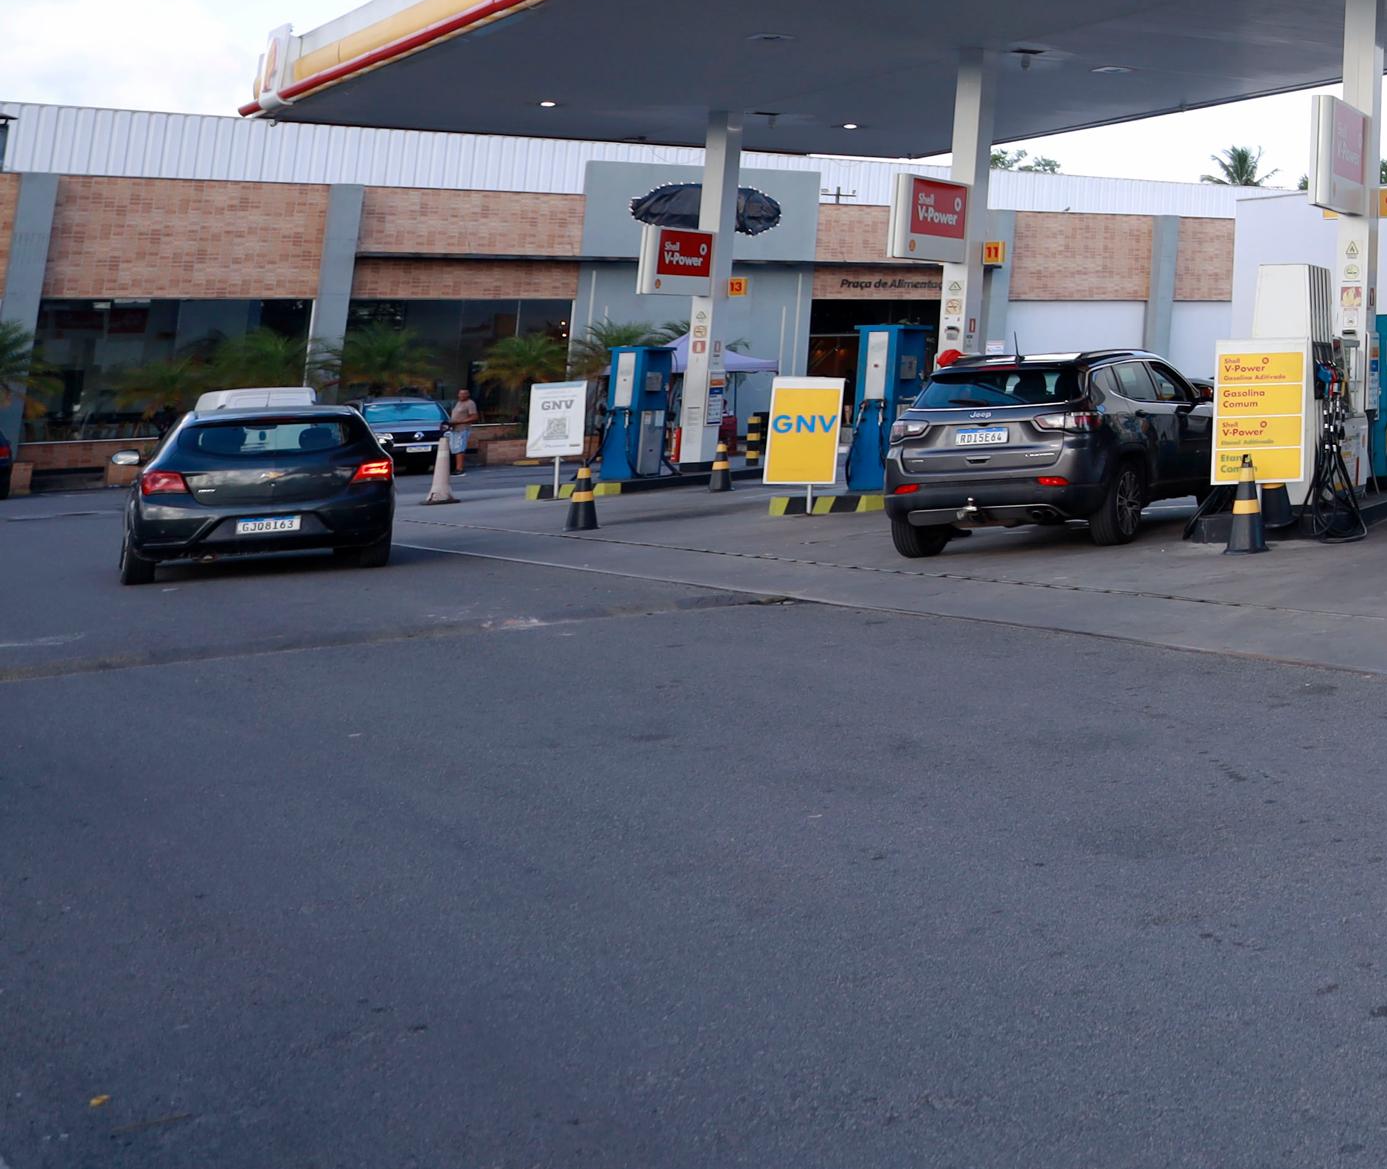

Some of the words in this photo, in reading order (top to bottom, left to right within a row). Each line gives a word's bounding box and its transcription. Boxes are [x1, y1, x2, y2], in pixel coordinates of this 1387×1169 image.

[918, 193, 935, 205] Shell
[918, 204, 958, 225] V-Power
[664, 241, 680, 251] Shell
[986, 246, 999, 258] 11
[664, 252, 703, 266] V-Power
[730, 281, 742, 292] 13
[840, 278, 871, 290] Praça
[874, 278, 887, 288] de
[1224, 364, 1265, 372] V-Power
[1223, 389, 1265, 398] Gasolina
[541, 399, 575, 411] GNV
[1223, 400, 1258, 408] Comum
[969, 410, 992, 420] Jeep
[772, 415, 837, 433] GNV
[1222, 428, 1263, 436] V-Power
